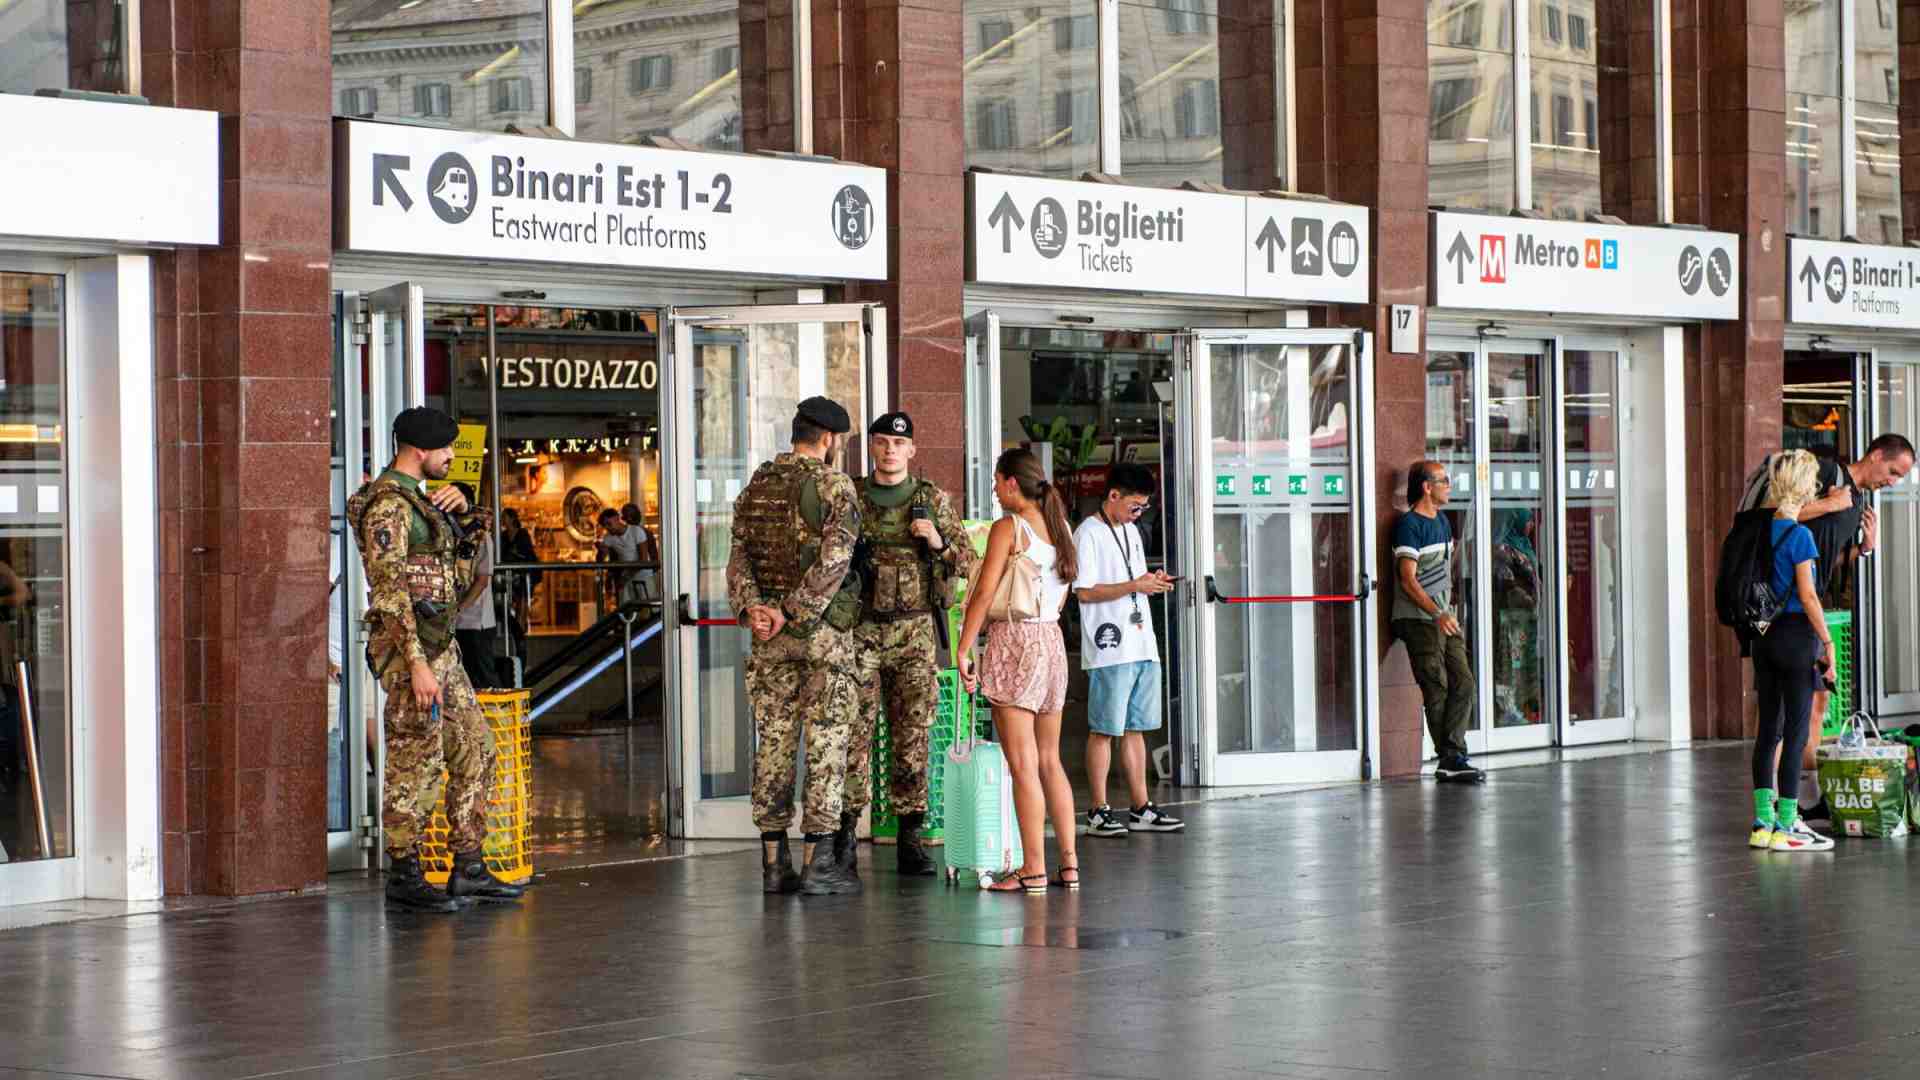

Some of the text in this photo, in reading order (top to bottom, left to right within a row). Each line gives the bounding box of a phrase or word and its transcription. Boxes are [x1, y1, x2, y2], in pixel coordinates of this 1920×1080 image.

[491, 155, 733, 214] Binari Est 1-2
[492, 206, 707, 251] Eastward Platforms
[1077, 199, 1184, 248] Biglietti
[1077, 242, 1133, 273] Tickets
[1515, 233, 1580, 268] Metro
[1852, 257, 1903, 288] Binari
[1852, 290, 1901, 315] Platforms
[1396, 309, 1412, 329] 17
[1858, 777, 1886, 793] BE
[1834, 793, 1873, 809] BAG
